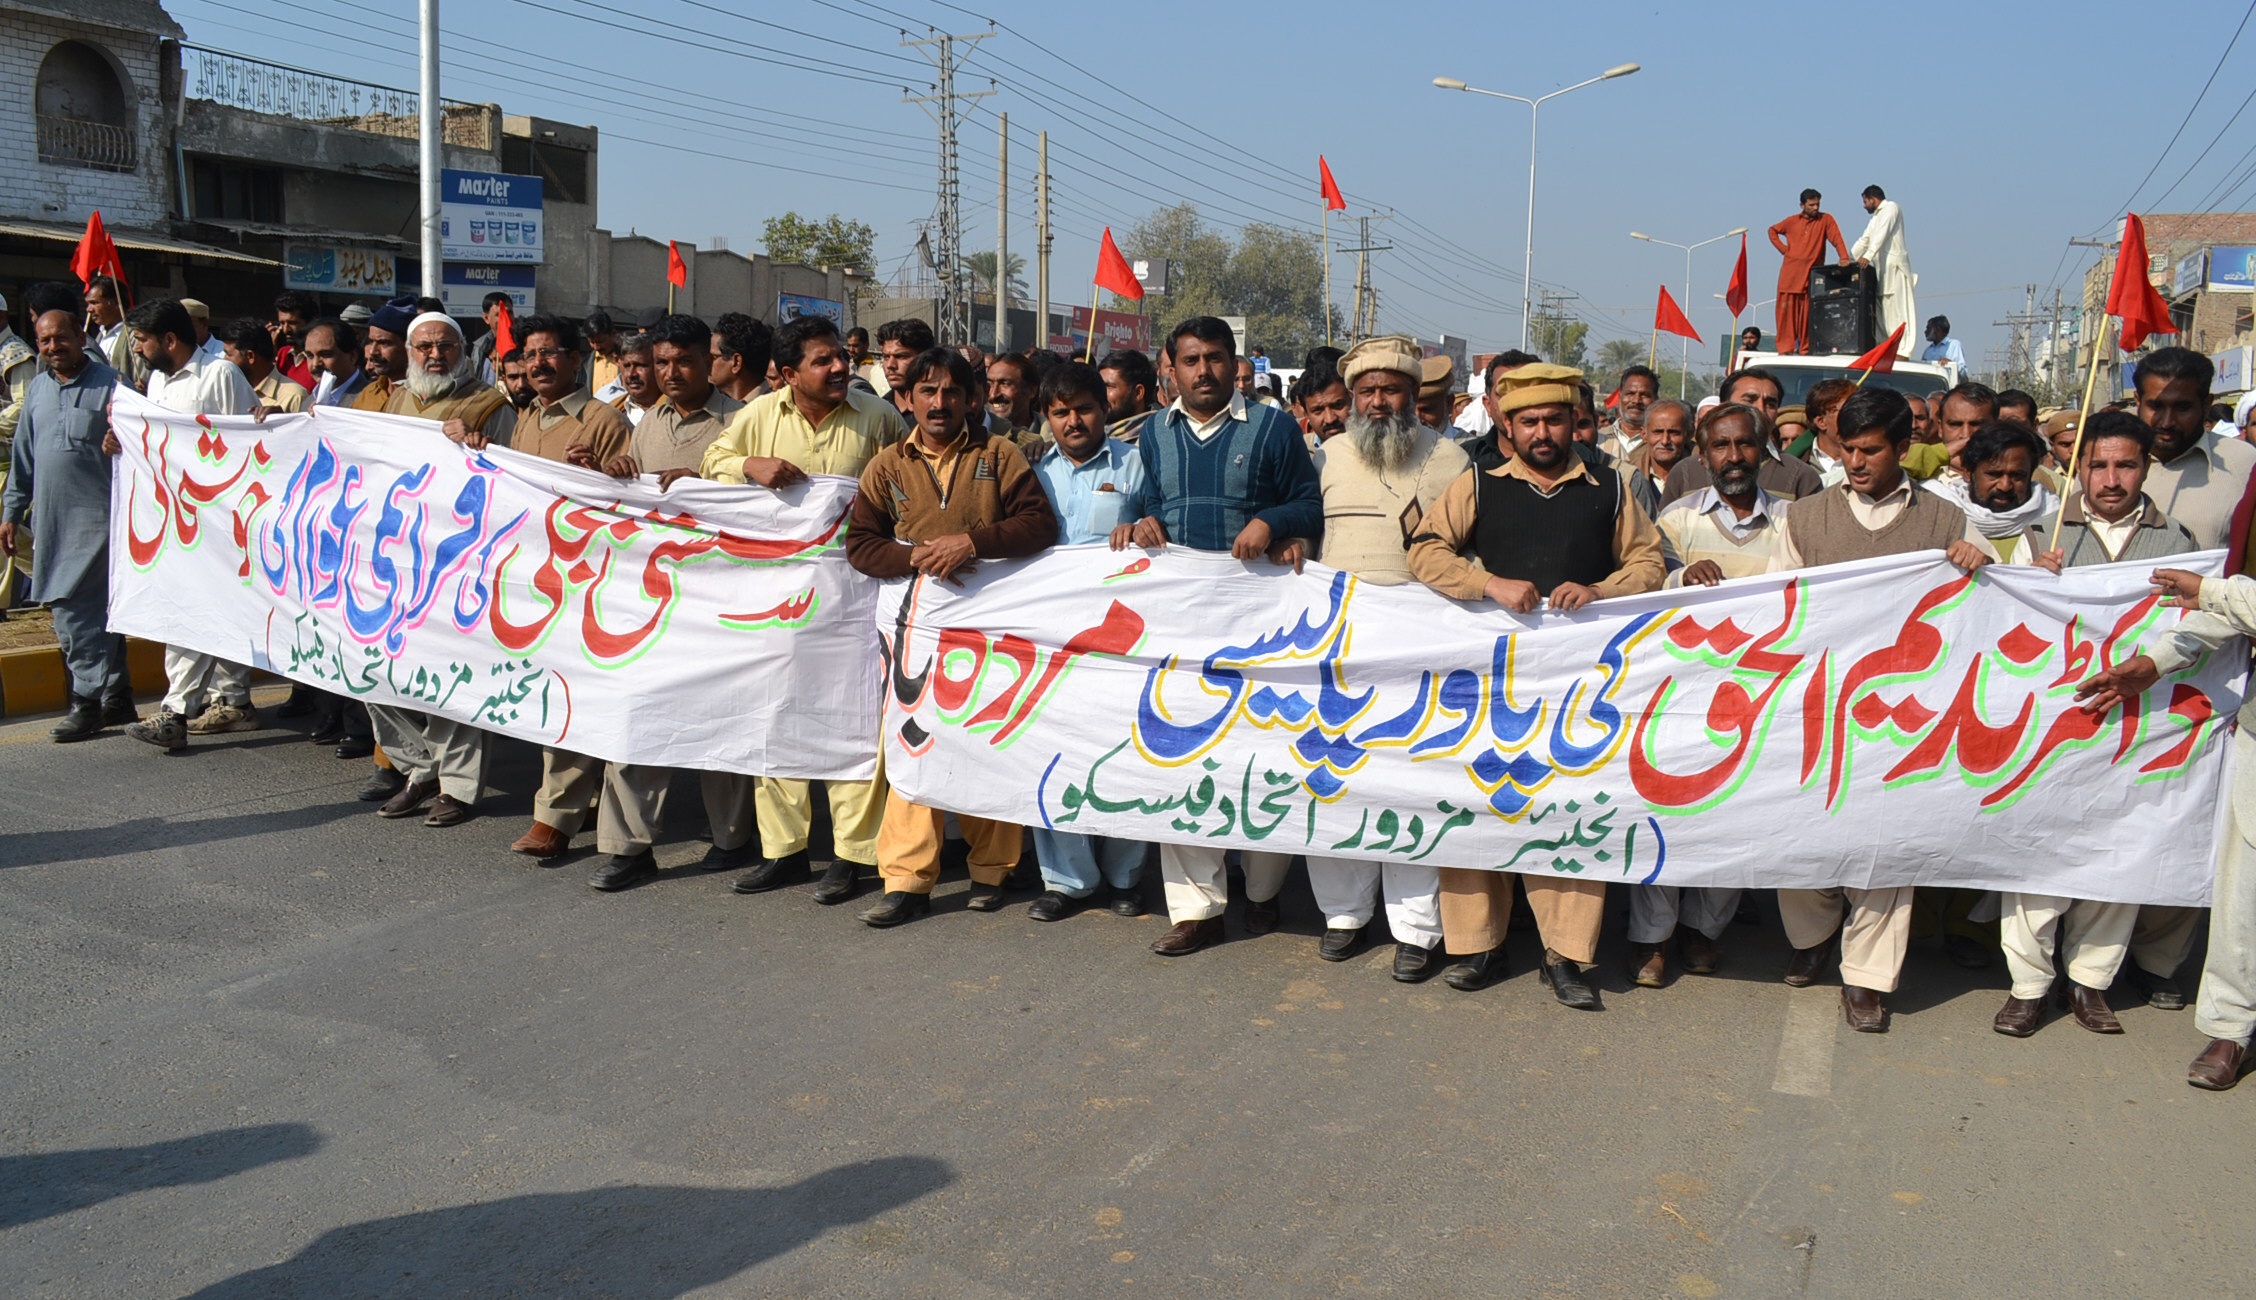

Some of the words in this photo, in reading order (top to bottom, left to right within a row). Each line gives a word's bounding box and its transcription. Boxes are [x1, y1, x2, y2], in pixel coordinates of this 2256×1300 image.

[458, 176, 511, 198] Master
[486, 196, 509, 206] PAINTS
[465, 266, 500, 280] Master
[1050, 343, 1074, 353] HONDA
[1104, 321, 1133, 342] Brighto
[453, 508, 531, 634] کی
[330, 631, 398, 697] اتحاد
[400, 660, 474, 709] مزدور
[1131, 570, 1379, 803] پالیسی
[1548, 607, 1682, 777] کی
[1629, 576, 1834, 816] الحق
[1826, 570, 2041, 816] ندیم
[1354, 633, 1557, 823] پاور
[1206, 752, 1317, 846] اتحاد
[1330, 799, 1476, 862] مزدور
